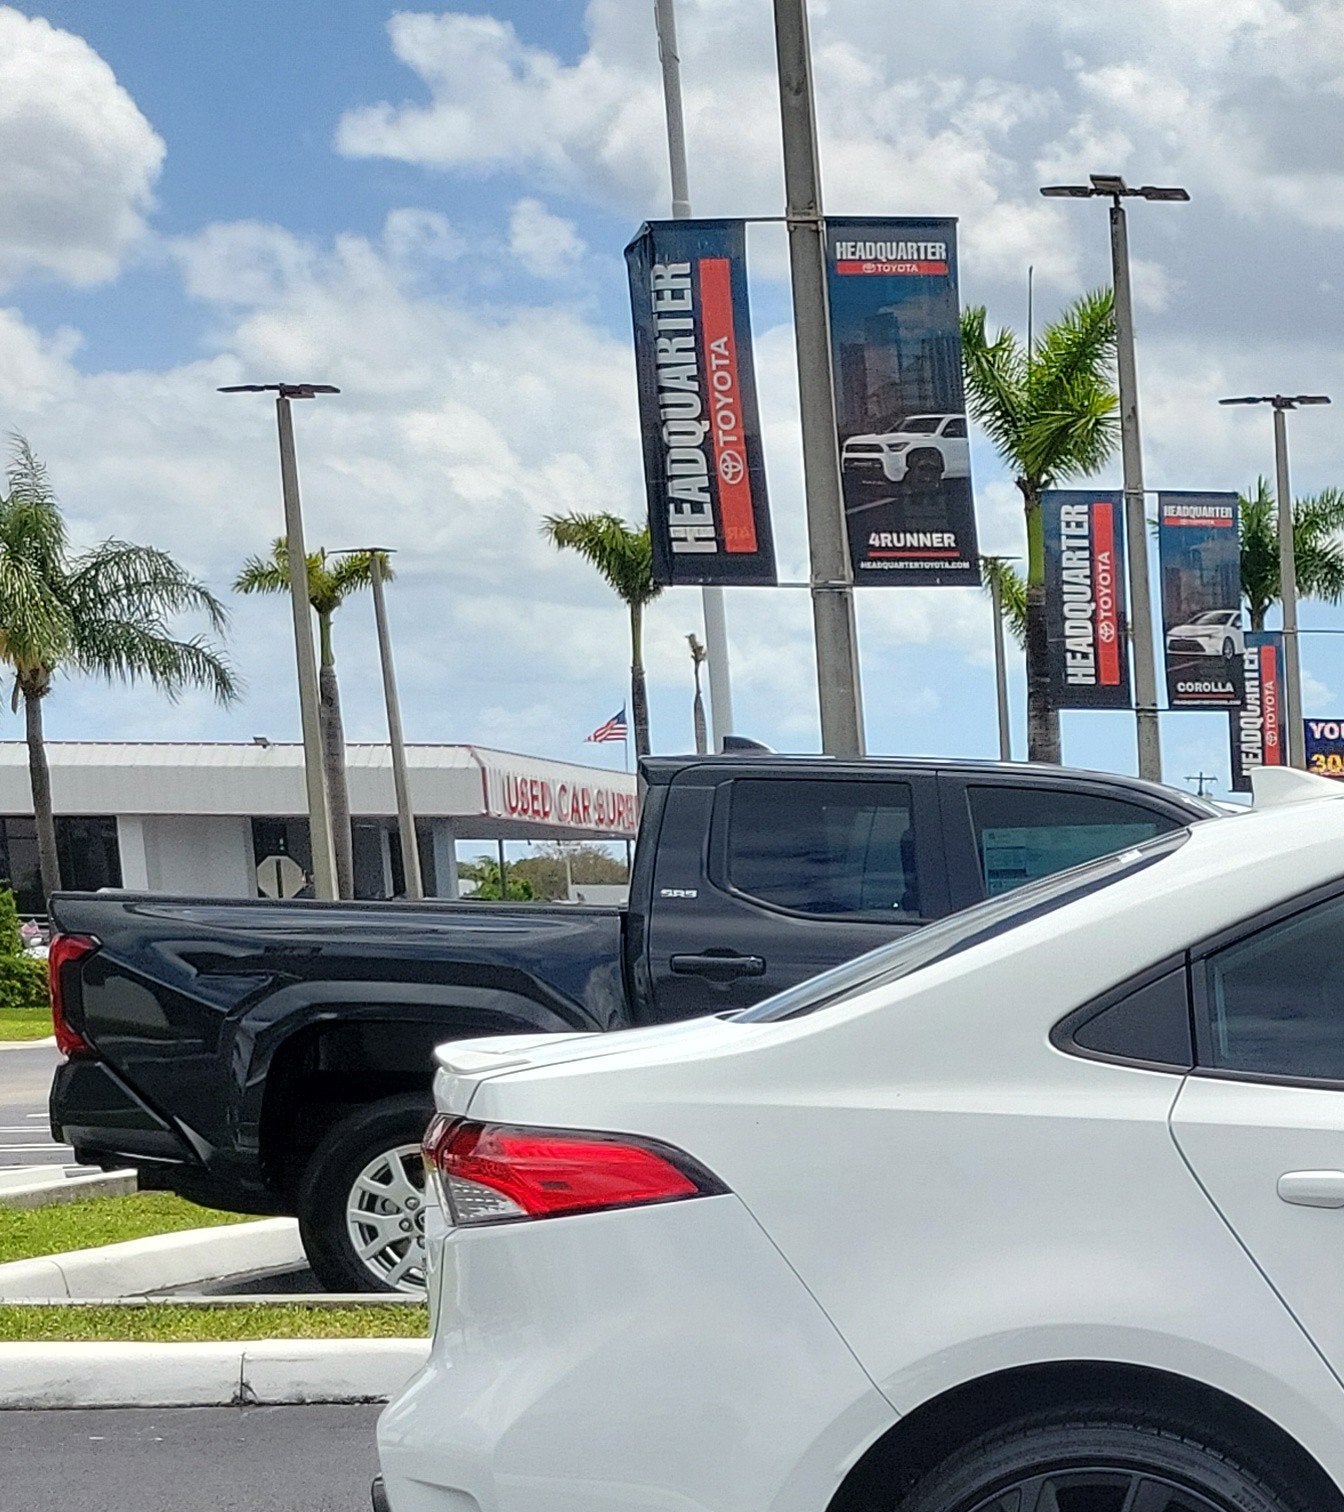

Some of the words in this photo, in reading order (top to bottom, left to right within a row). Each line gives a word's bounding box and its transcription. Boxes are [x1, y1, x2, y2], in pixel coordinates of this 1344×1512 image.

[836, 241, 947, 262] HEADQUARTER
[877, 263, 919, 273] TOYOTA
[650, 262, 718, 553] HEADQUARTER
[710, 336, 742, 447] TOYOTA
[868, 532, 956, 547] 4RUNNER
[1060, 504, 1096, 685] HEADQUARTER
[1097, 551, 1113, 619] TOYOTA
[1177, 682, 1234, 692] COROLLA
[1264, 680, 1278, 729] TOYOTA
[506, 775, 551, 819] USED
[557, 784, 591, 824] CAR
